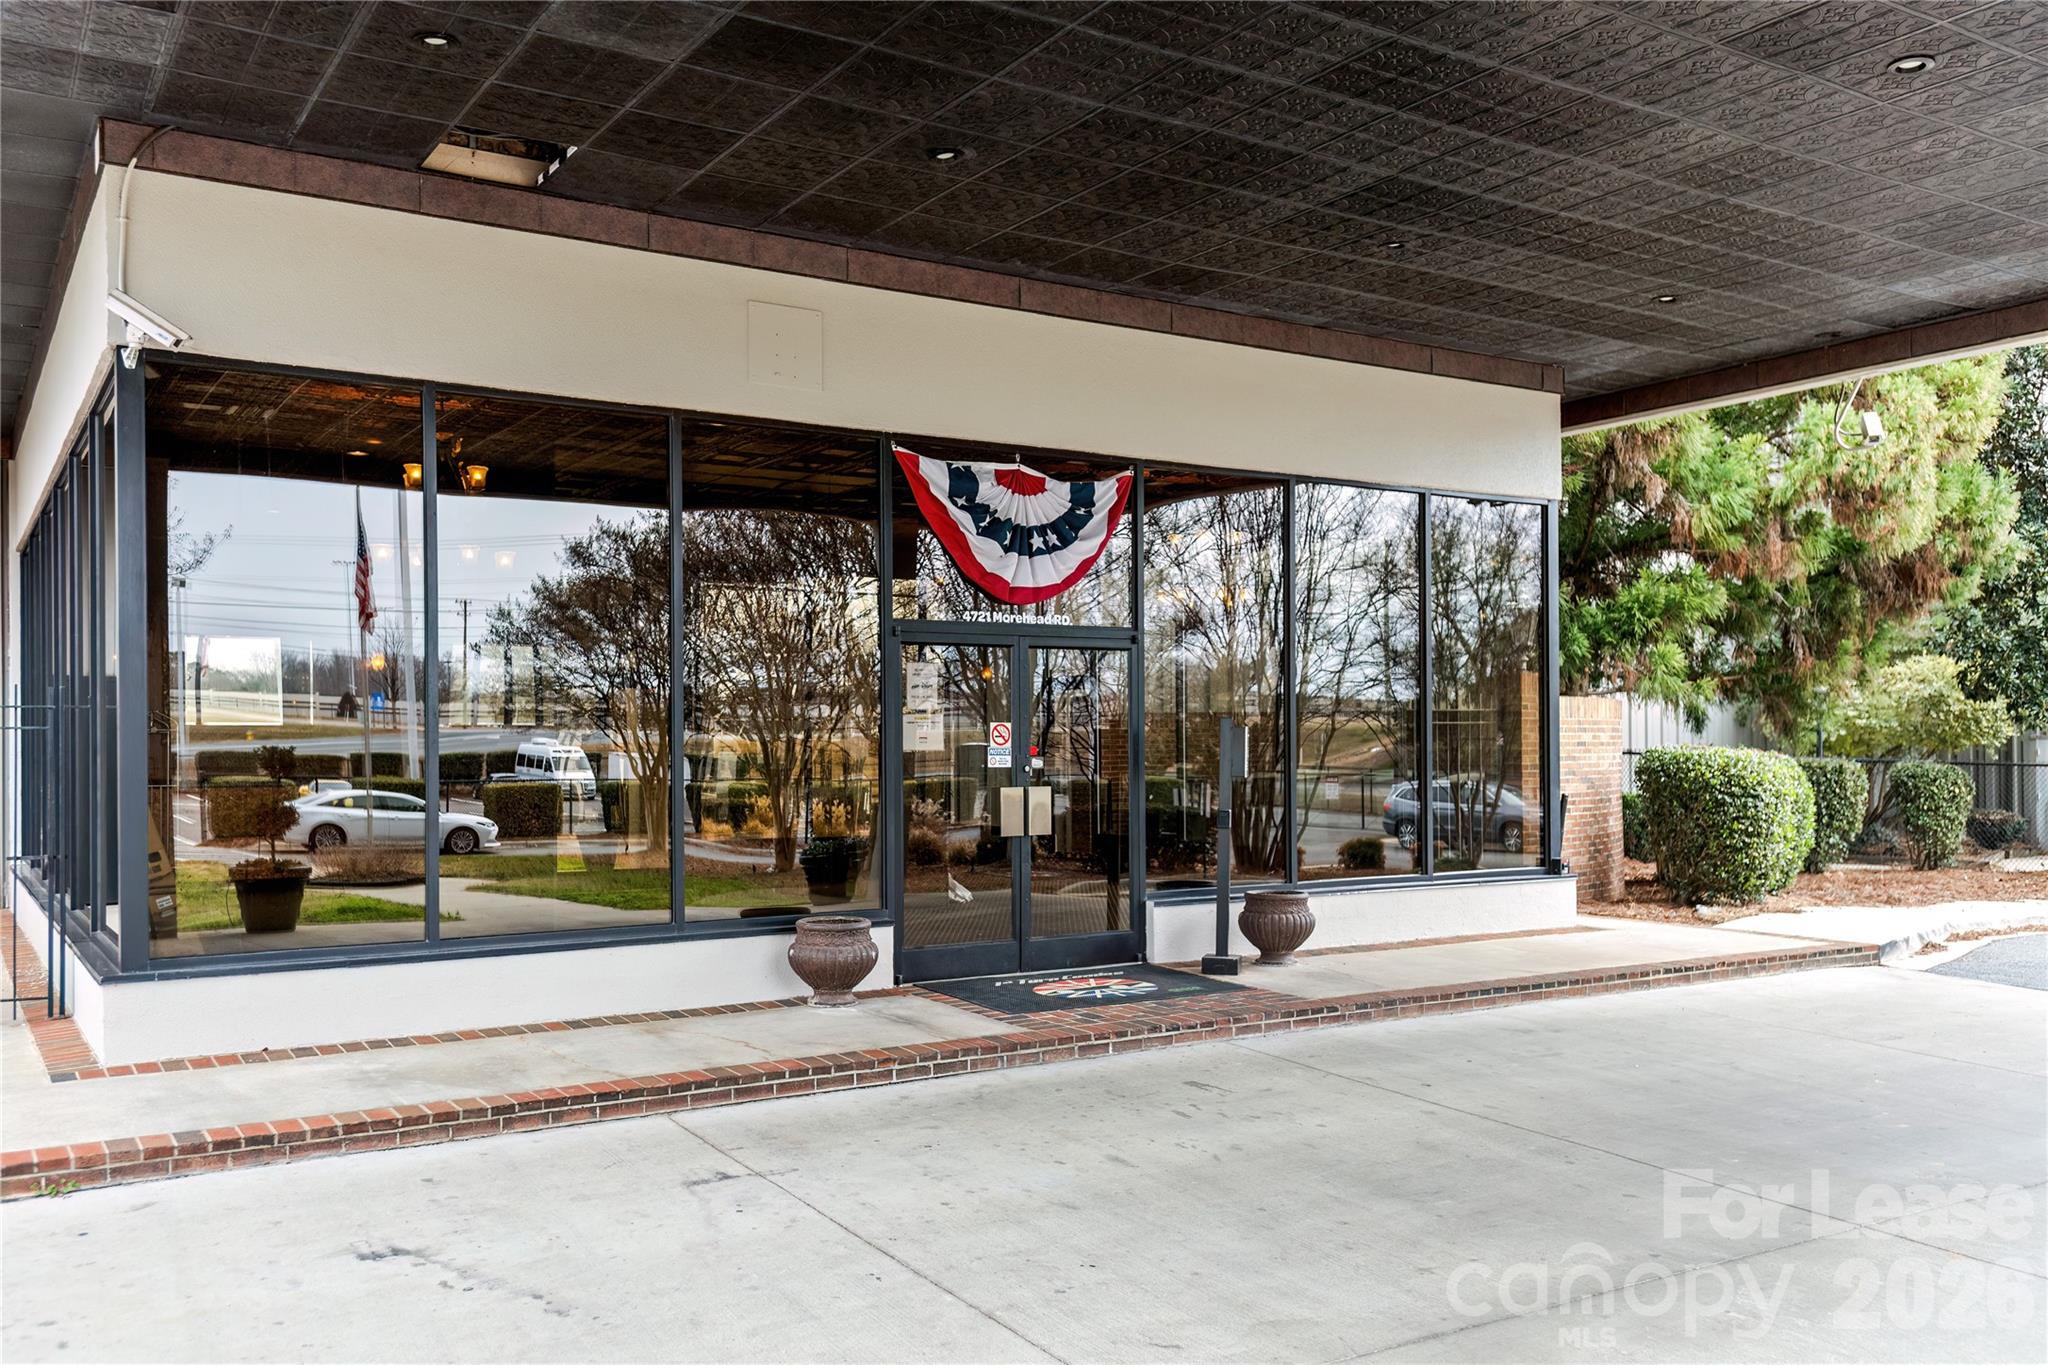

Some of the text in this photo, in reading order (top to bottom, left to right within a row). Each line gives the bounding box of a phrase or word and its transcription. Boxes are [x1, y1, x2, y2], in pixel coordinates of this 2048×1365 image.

[963, 610, 1073, 626] 4721 Morehead RD.
